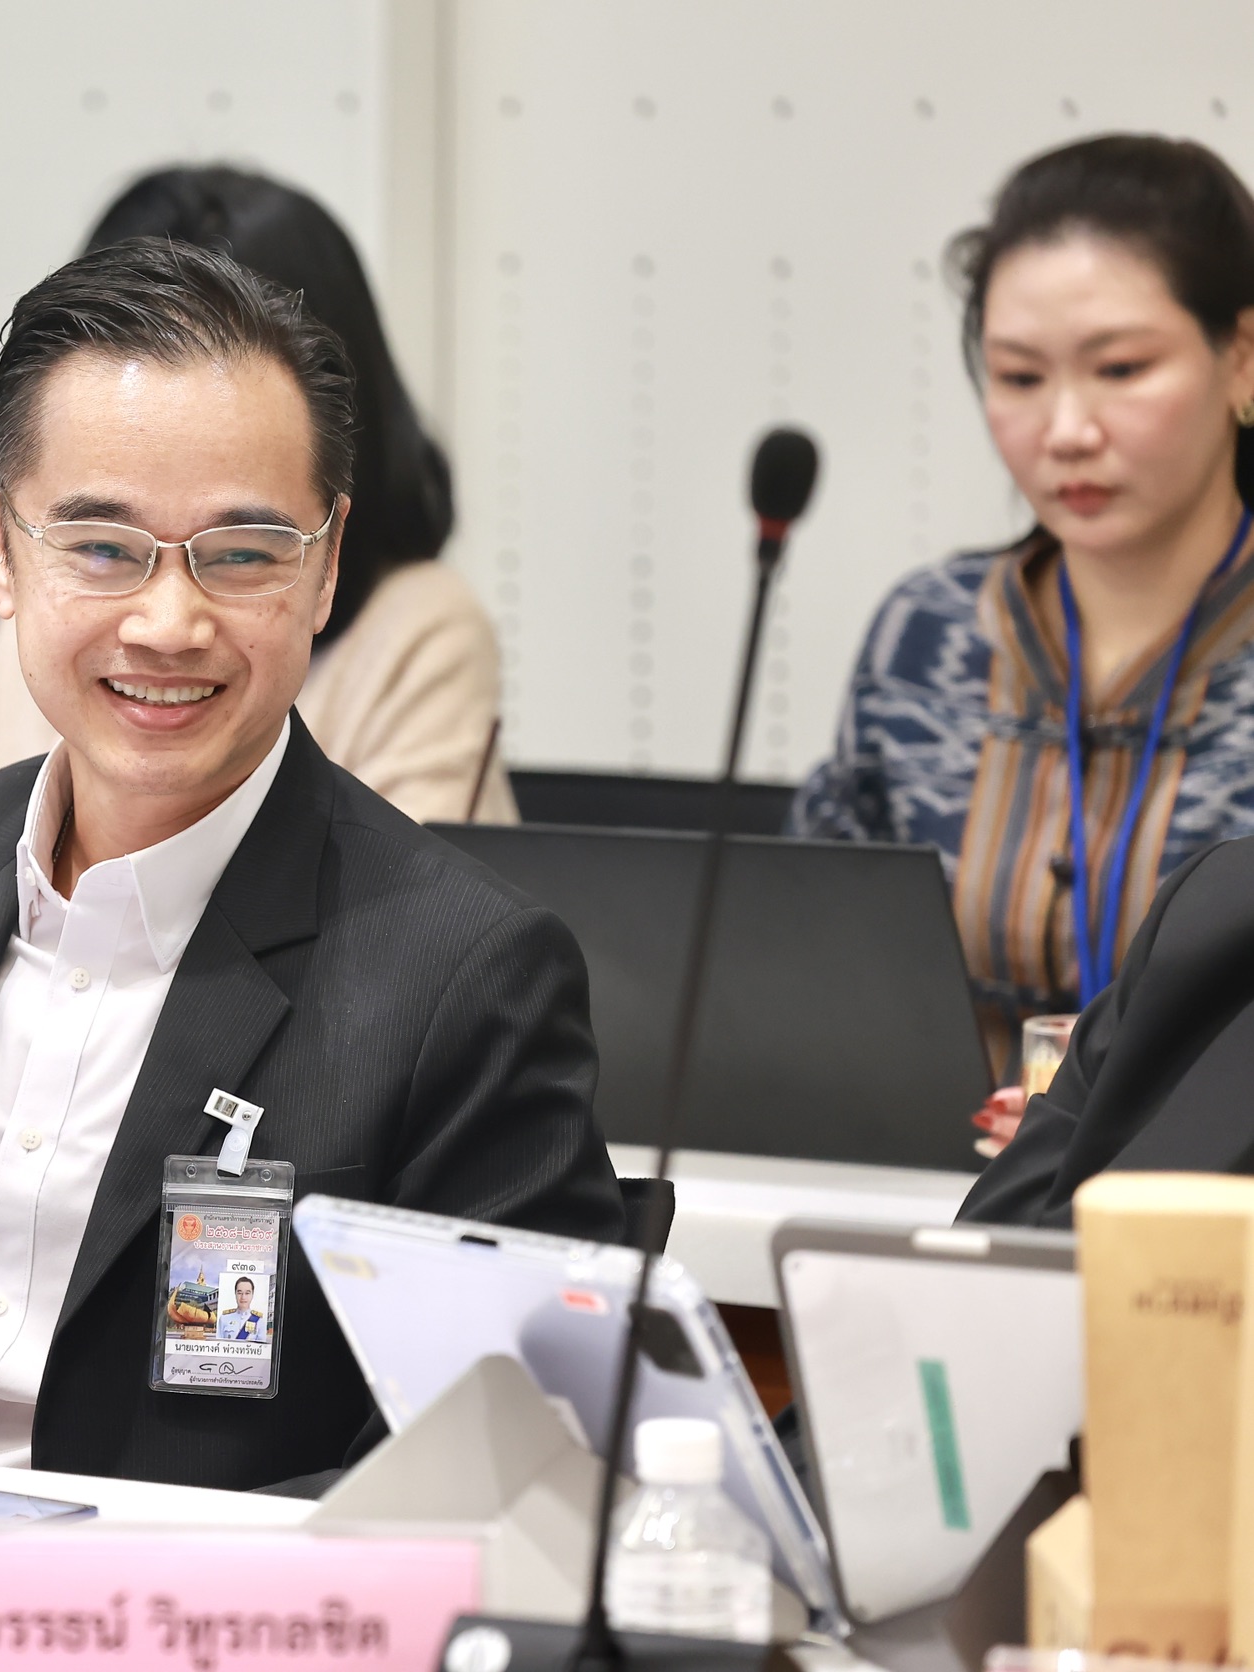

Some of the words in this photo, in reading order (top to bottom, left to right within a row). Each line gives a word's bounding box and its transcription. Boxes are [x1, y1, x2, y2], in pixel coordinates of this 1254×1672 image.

[194, 1240, 274, 1252] ประสานงานส่วนราชการ
[231, 1262, 256, 1272] ๙๓๑
[175, 1343, 220, 1353] นายเวทางค์
[223, 1344, 262, 1355] พ่วงทรัพย์
